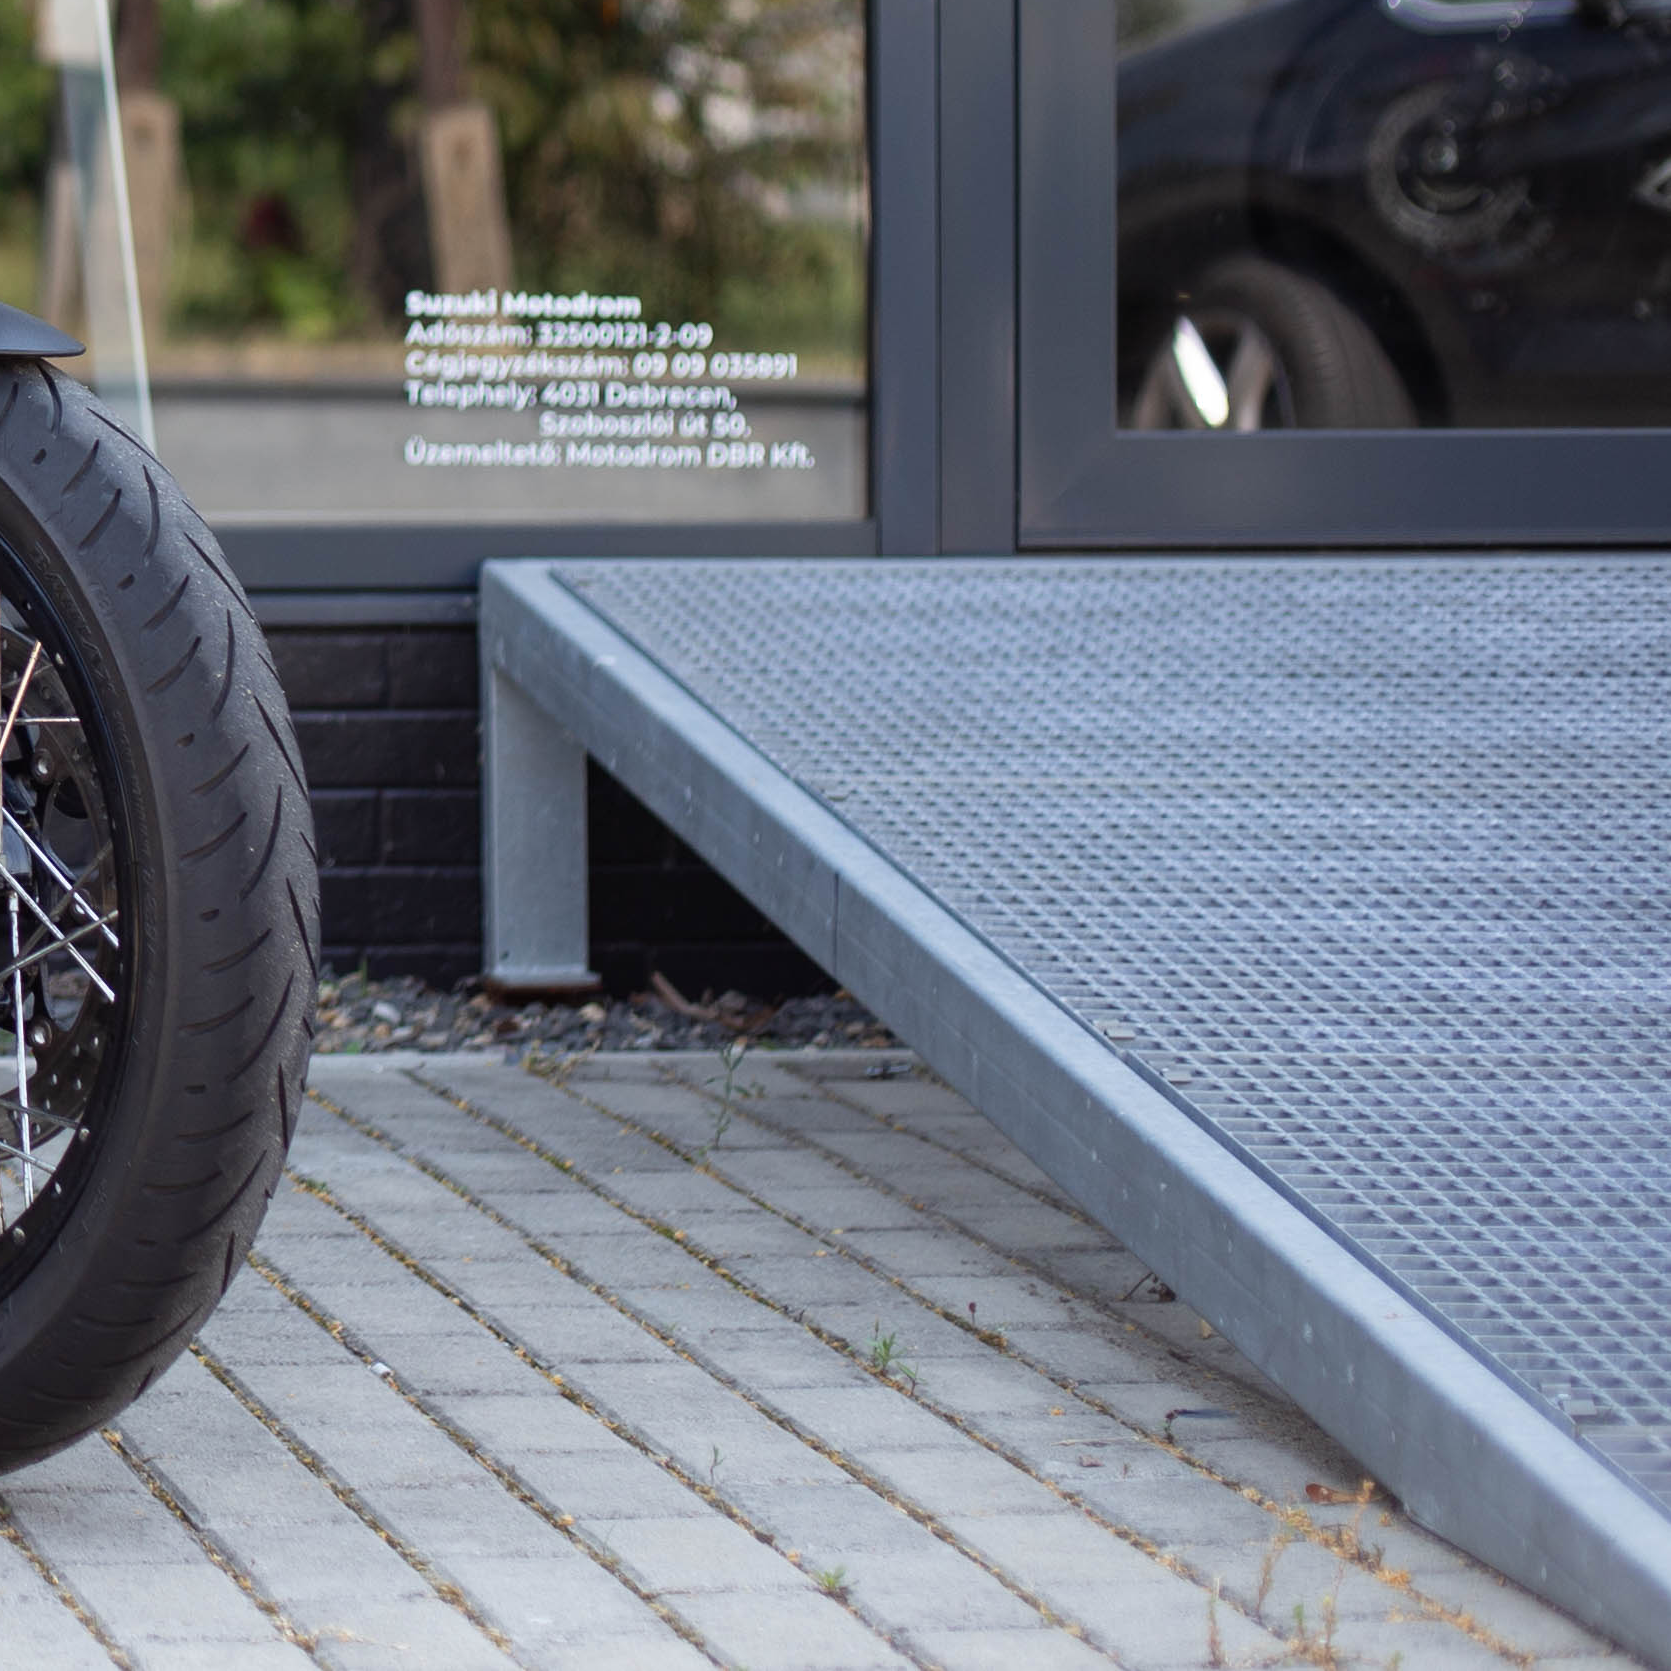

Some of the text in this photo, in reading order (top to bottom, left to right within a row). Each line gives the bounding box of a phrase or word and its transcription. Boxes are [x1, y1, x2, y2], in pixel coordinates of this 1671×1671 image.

[405, 288, 641, 318] Suzuki Motodrom
[535, 321, 714, 348] 32500121-2-09
[632, 352, 667, 378] 09
[671, 352, 706, 378] 09
[404, 379, 737, 411] Telephely: 4031 Debrecen,
[566, 440, 702, 466] Motodrom
[707, 442, 765, 467] DBR
